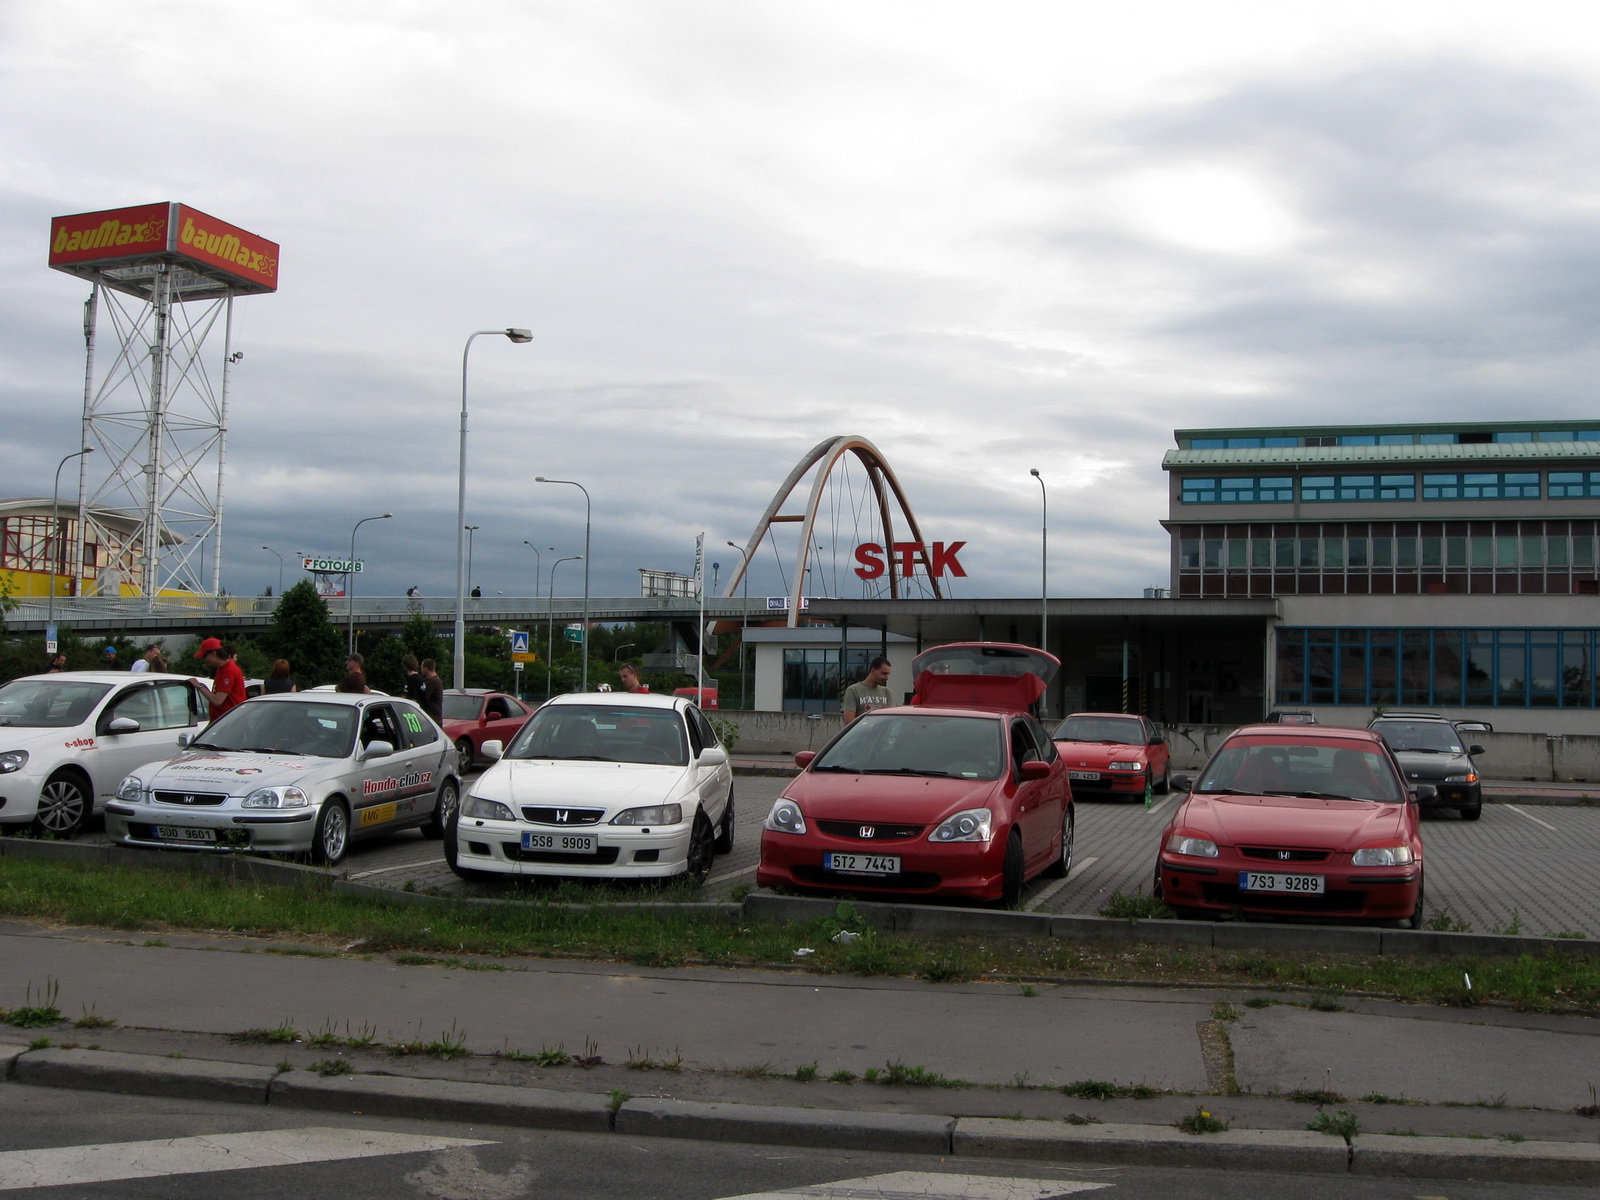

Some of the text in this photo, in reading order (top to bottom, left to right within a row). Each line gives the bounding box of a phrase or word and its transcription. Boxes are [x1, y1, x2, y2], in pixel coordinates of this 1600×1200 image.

[313, 560, 362, 572] FOTOLAB
[854, 541, 968, 579] STK
[65, 738, 94, 749] e-shop
[185, 829, 211, 840] 9601
[532, 835, 553, 847] 5S8
[562, 837, 591, 849] 9909
[833, 855, 856, 869] 5T2
[864, 857, 895, 871] 7443
[1251, 875, 1275, 889] 7S3
[1285, 877, 1318, 891] 9289
